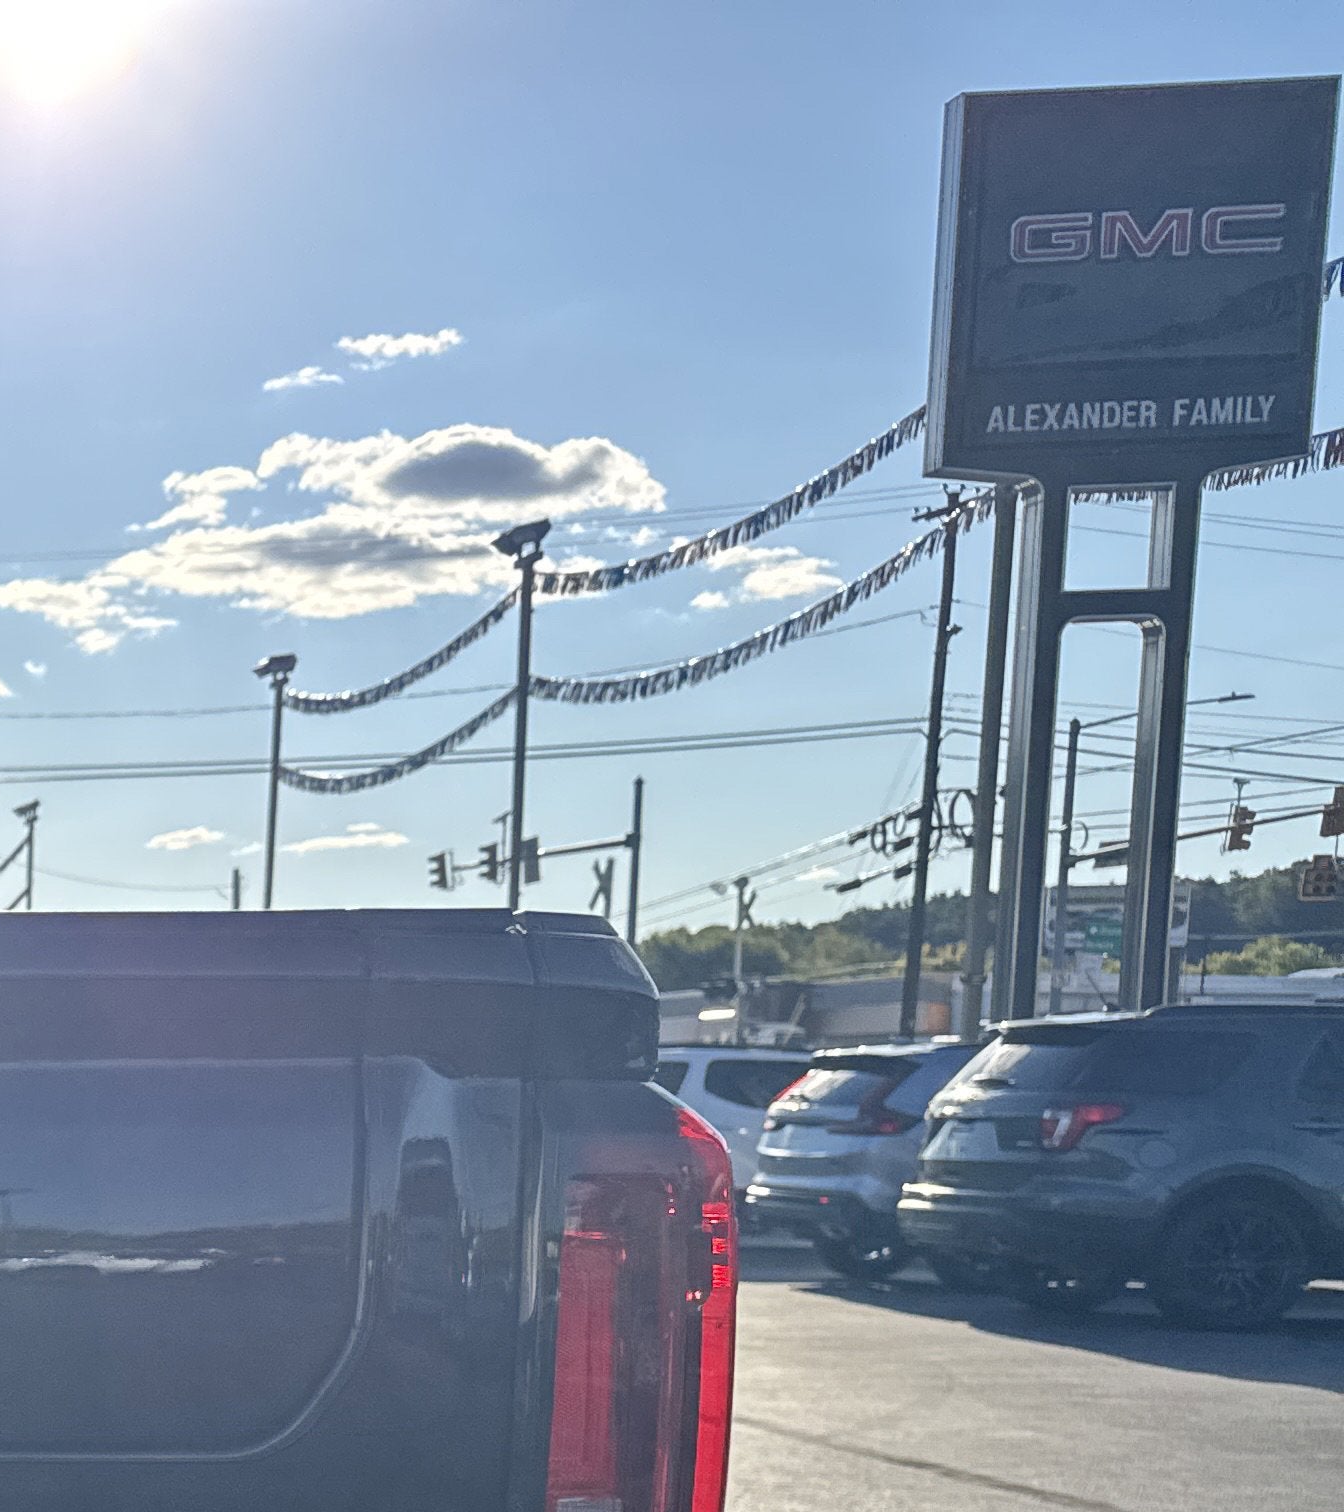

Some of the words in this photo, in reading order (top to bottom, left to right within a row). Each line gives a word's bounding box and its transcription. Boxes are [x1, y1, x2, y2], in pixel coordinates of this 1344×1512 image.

[1011, 203, 1285, 263] GMC
[986, 400, 1158, 433] ALEXANDER
[1172, 395, 1276, 427] FAMILY
